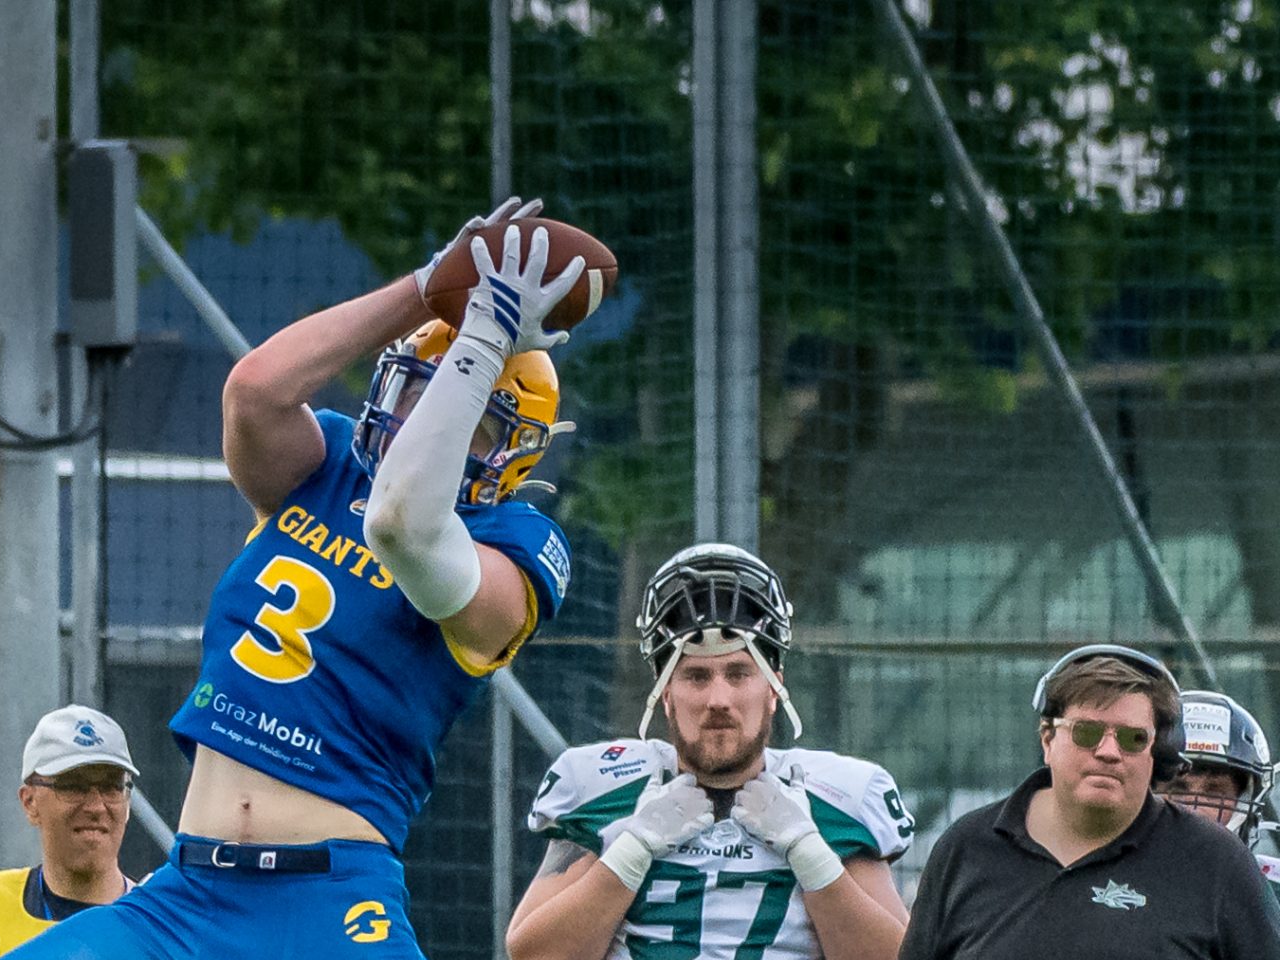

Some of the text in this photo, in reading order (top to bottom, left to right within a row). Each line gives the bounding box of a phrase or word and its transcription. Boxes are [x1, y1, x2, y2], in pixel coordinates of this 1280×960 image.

[278, 505, 394, 589] GIANTS
[229, 555, 336, 684] 3
[213, 692, 322, 755] Graz Mobil
